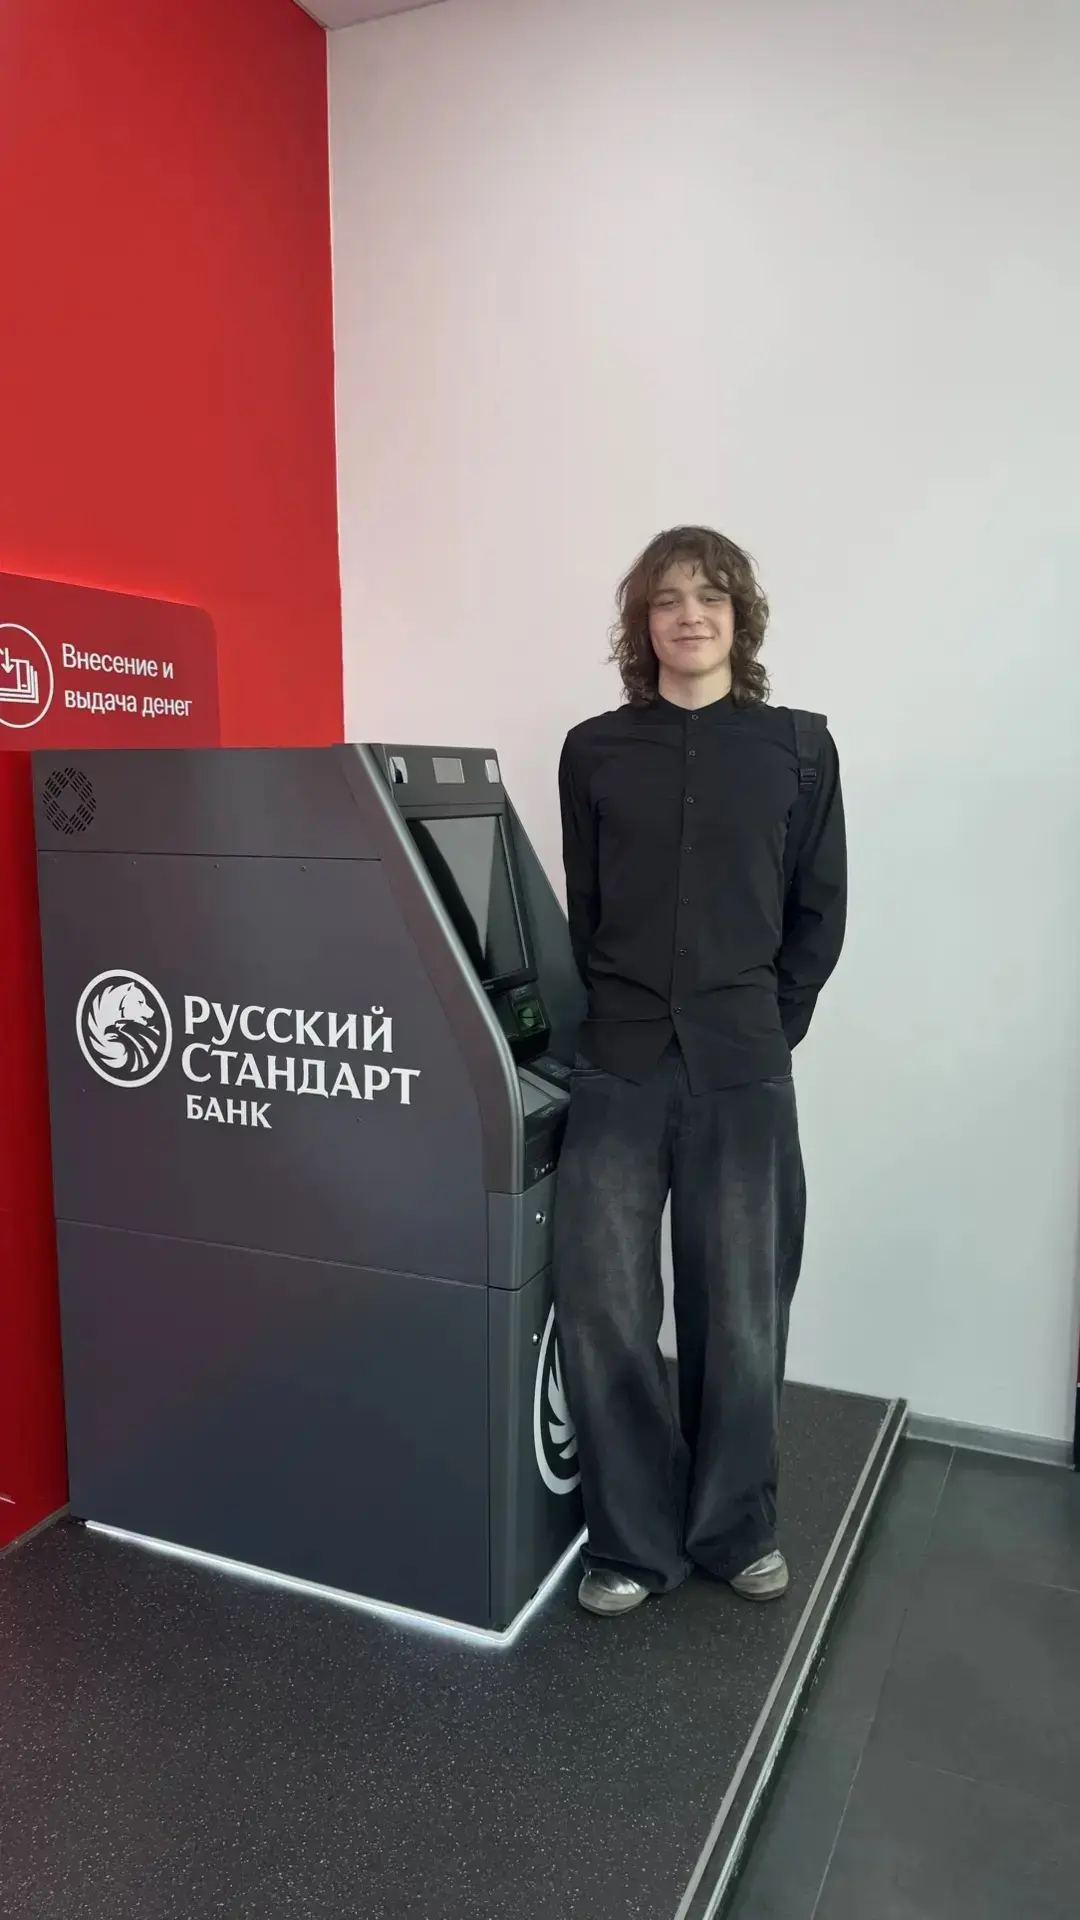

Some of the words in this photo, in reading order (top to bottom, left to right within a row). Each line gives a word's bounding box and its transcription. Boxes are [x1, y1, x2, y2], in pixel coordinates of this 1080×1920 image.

[61, 642, 158, 678] Внесение
[162, 661, 174, 680] и
[64, 689, 138, 715] выдача
[141, 696, 193, 718] денег
[186, 1094, 273, 1129] БАНК
